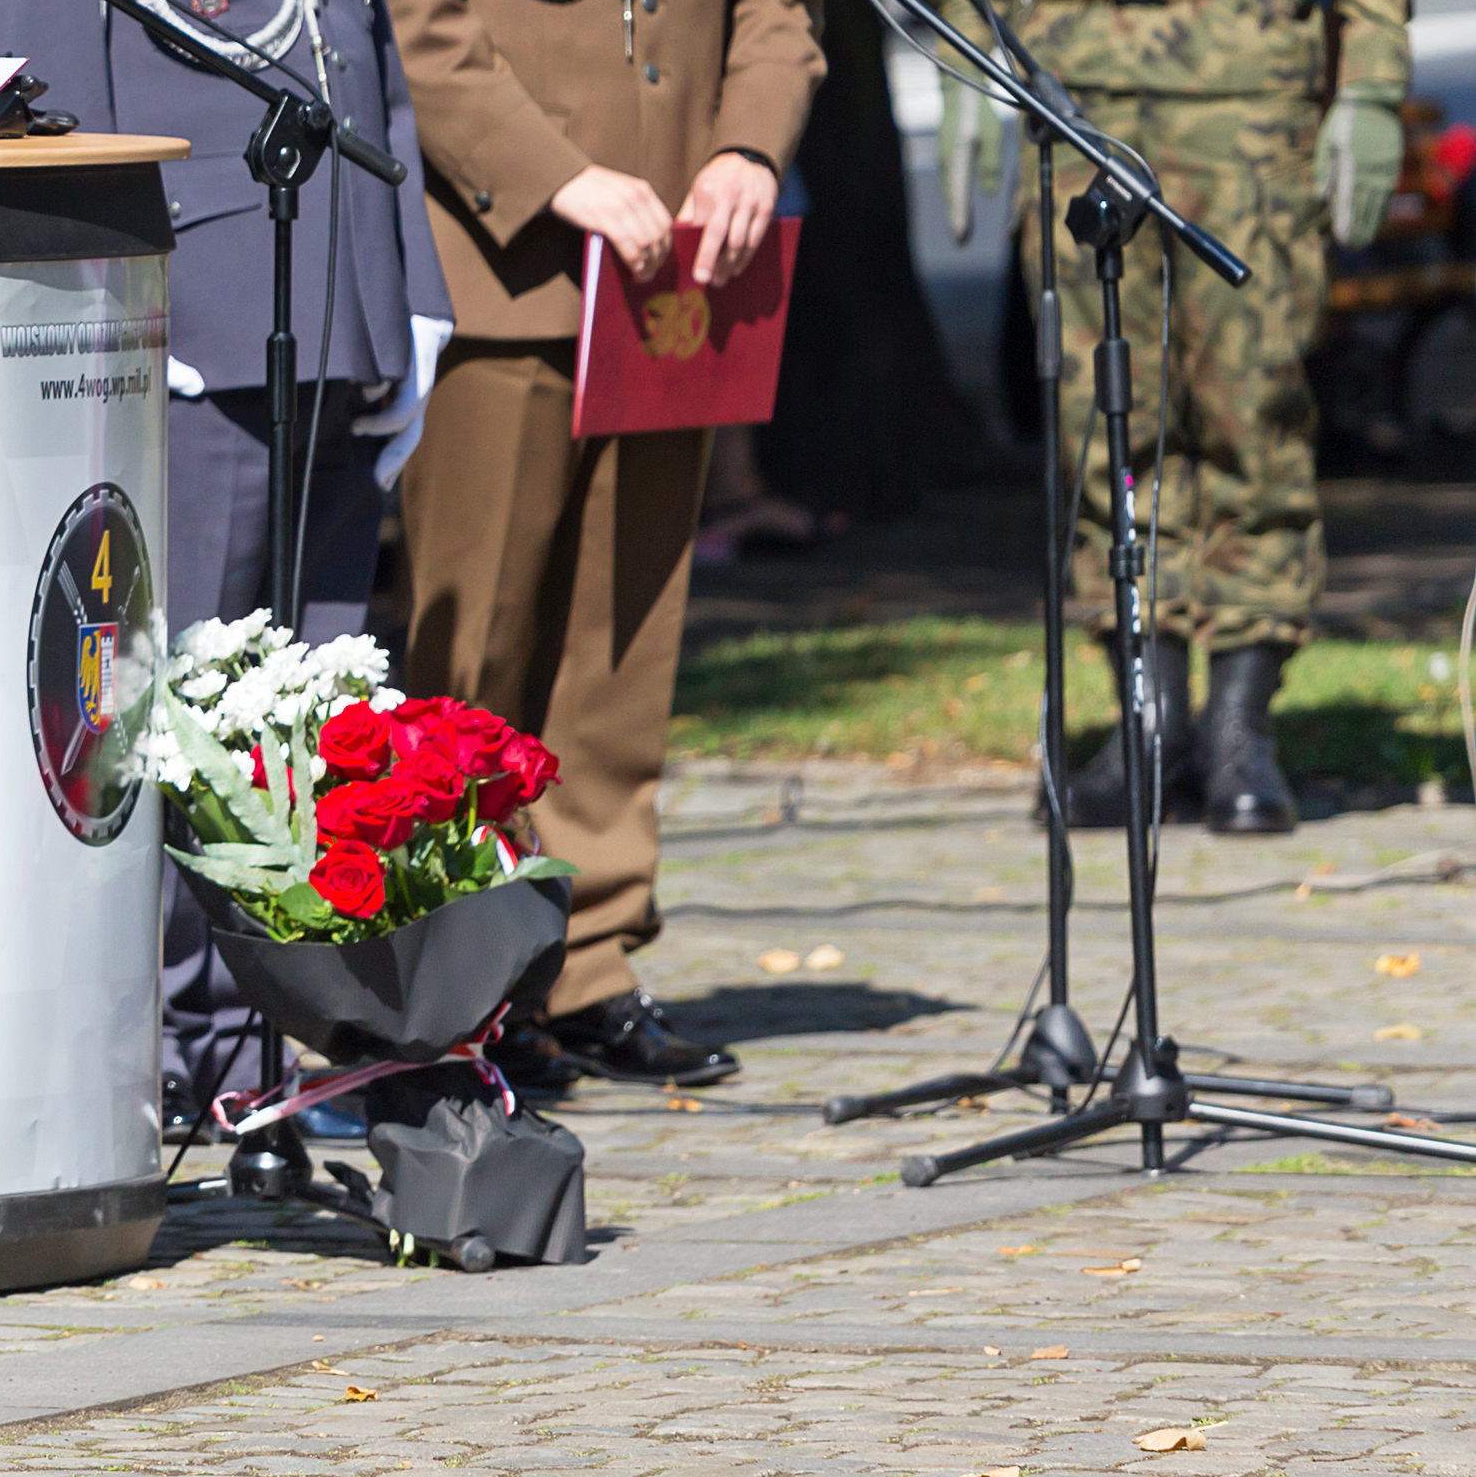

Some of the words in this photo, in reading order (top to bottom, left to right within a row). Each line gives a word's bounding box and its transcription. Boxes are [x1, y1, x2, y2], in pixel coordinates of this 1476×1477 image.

[1, 323, 76, 358] WOJSKOWY
[40, 366, 152, 404] www.4wog.wp.mil.pl
[91, 529, 113, 604] 4
